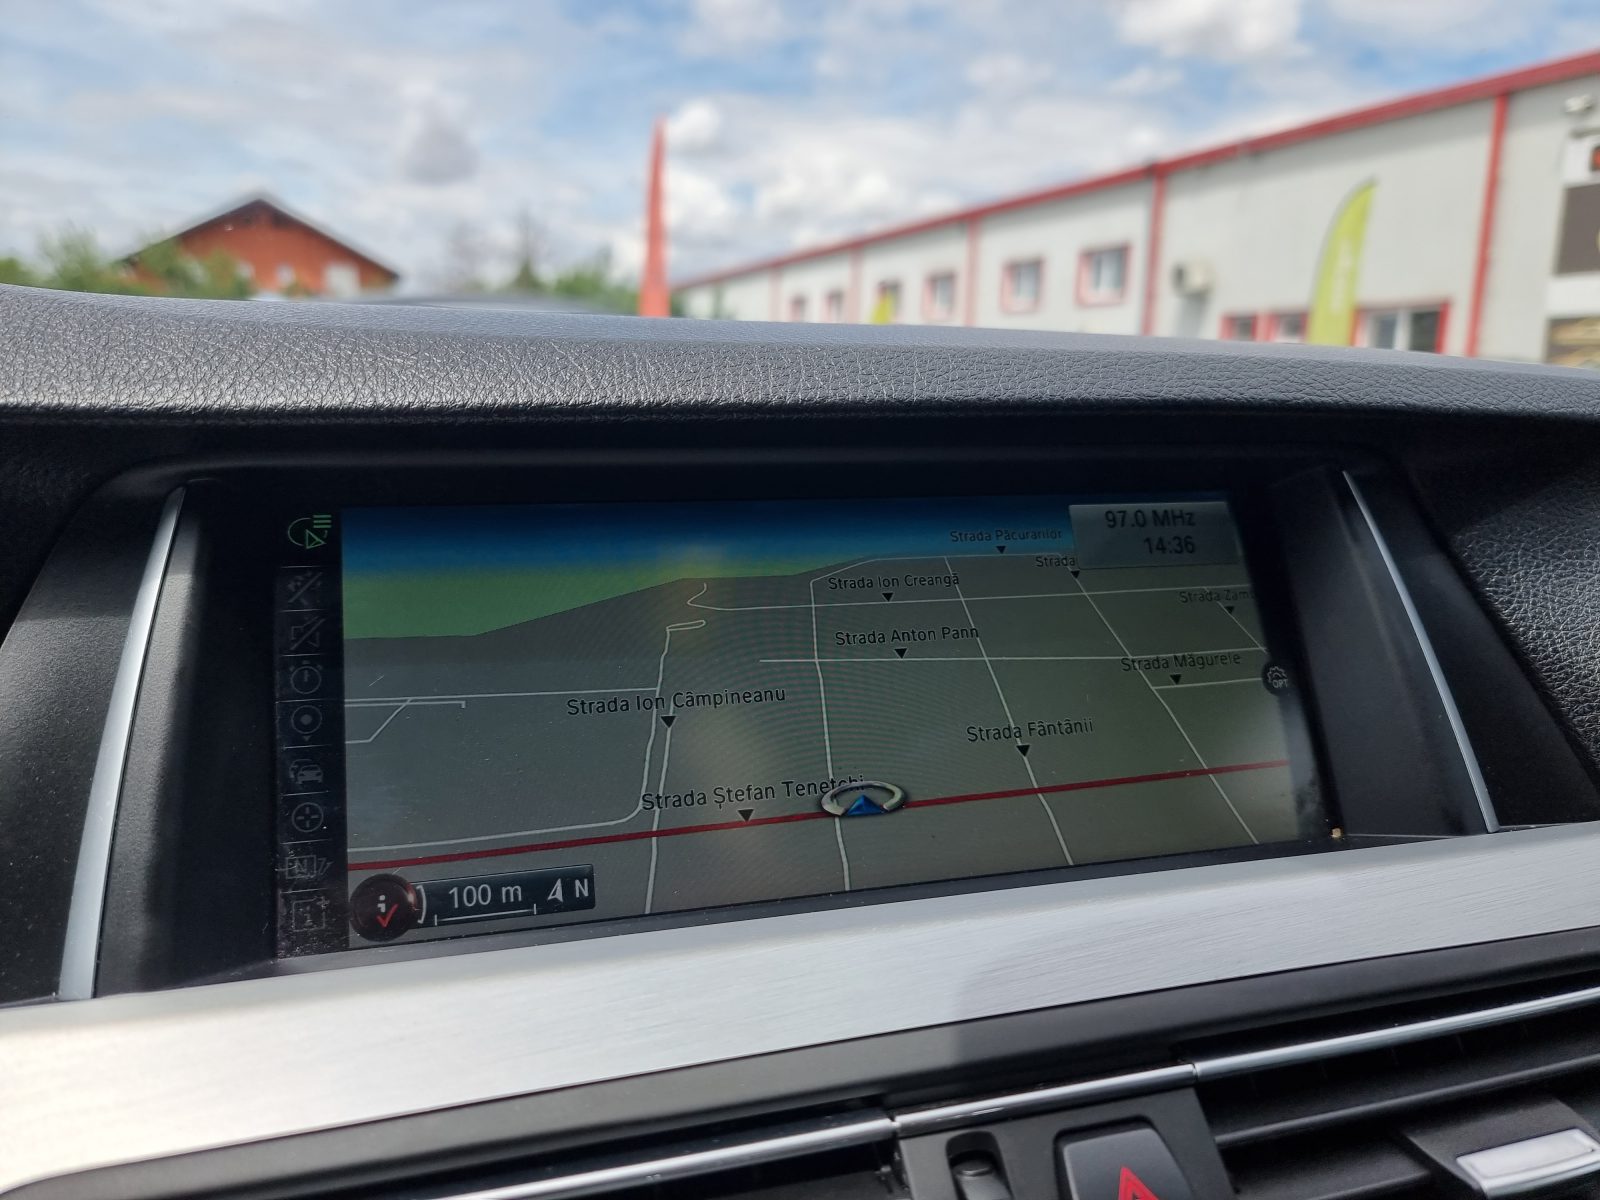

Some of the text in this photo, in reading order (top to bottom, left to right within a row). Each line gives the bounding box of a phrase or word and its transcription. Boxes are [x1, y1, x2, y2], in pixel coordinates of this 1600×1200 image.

[1104, 509, 1196, 529] 97.0 MHz
[949, 530, 992, 543] Strada
[1143, 535, 1196, 554] 14:36
[1035, 556, 1076, 568] Strada
[828, 572, 960, 590] Strada Ion Creangă
[1178, 590, 1221, 604] Strada
[835, 626, 979, 646] Strada Anton Pann
[1120, 656, 1169, 672] Strada
[566, 686, 787, 716] Strada Ion Câmpineanu
[966, 718, 1094, 742] Strada Fântânii
[641, 788, 707, 811] Strada
[448, 878, 589, 909] 100 m N
